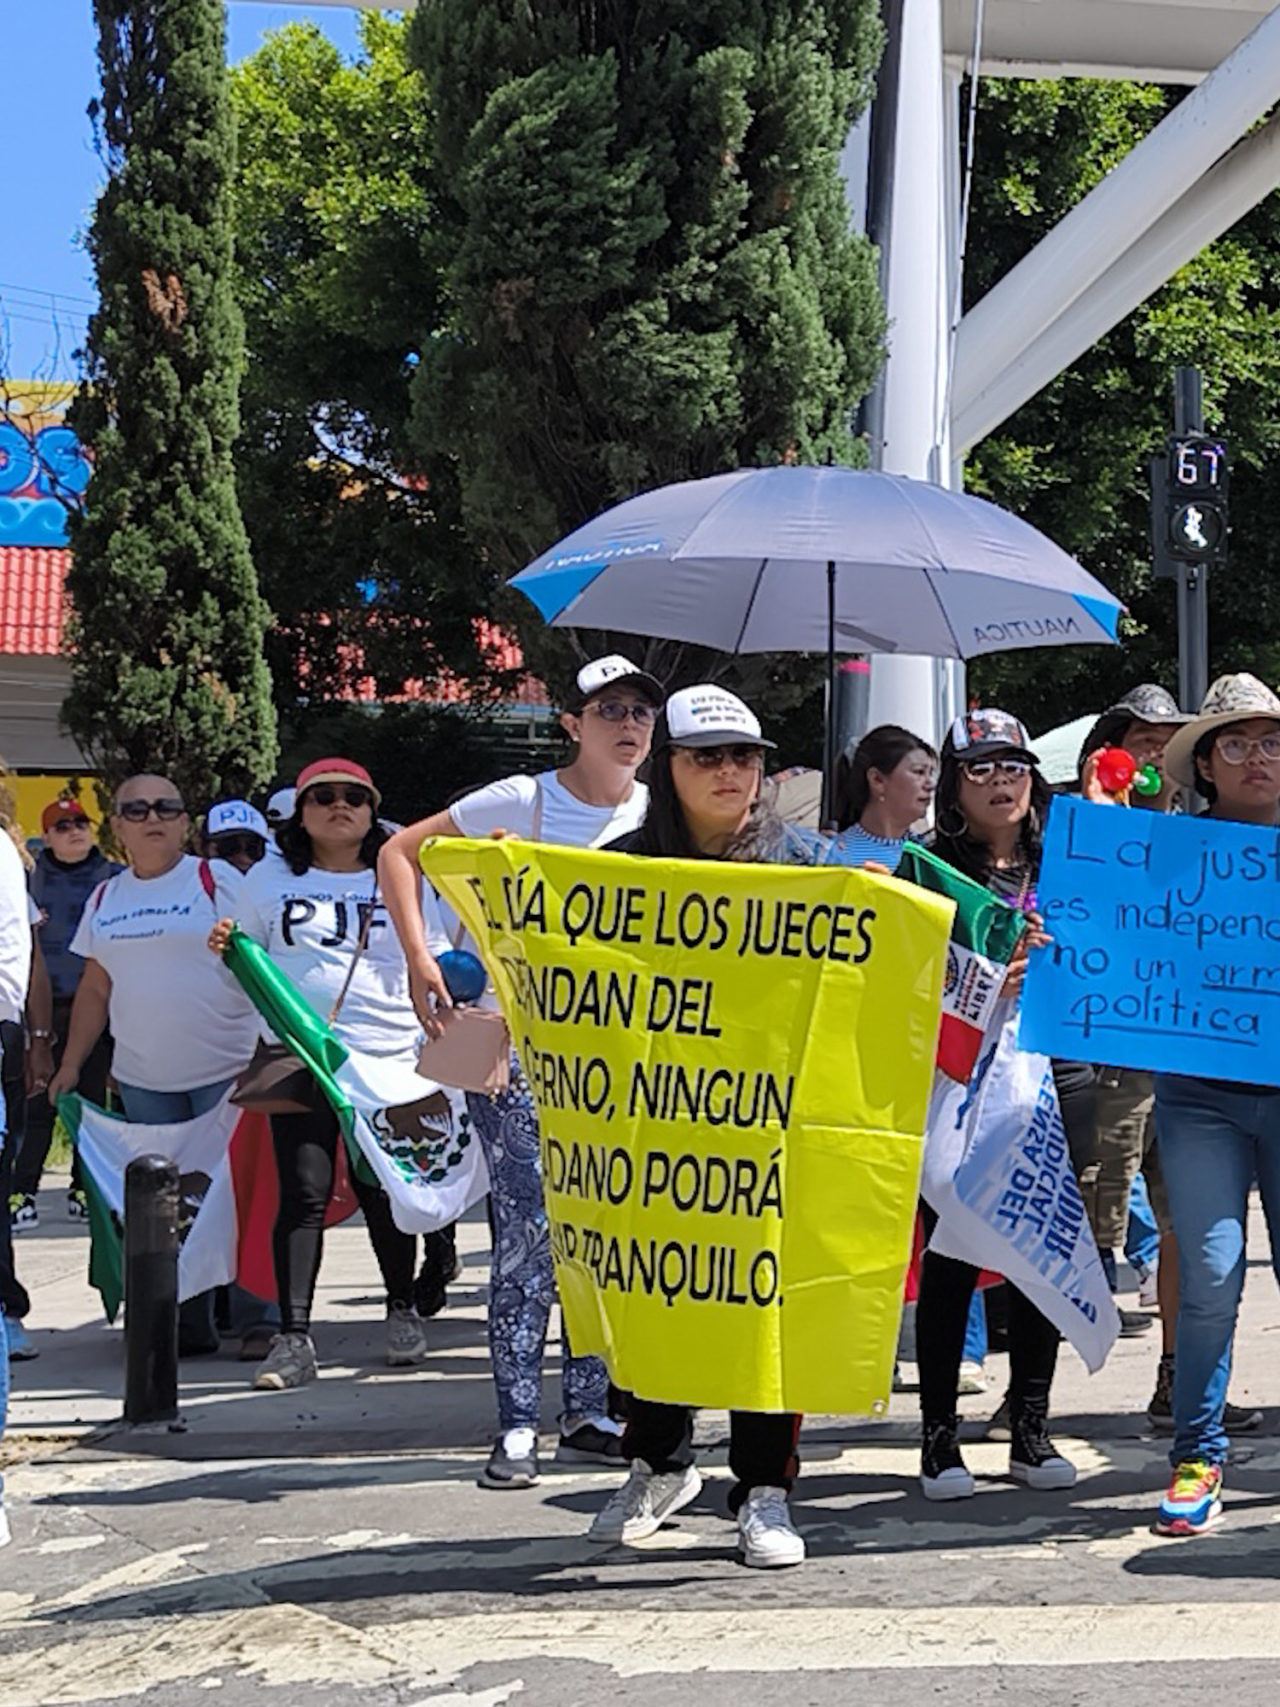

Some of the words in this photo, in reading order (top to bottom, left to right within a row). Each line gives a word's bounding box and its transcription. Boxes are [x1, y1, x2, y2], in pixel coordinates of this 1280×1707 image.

[1177, 448, 1219, 485] 67
[1066, 807, 1152, 871] La
[281, 898, 388, 950] PJF
[562, 883, 646, 947] QUE
[654, 890, 731, 951] LOS
[738, 898, 877, 964] JUECES
[1042, 896, 1091, 922] es
[1052, 942, 1111, 980] no
[1134, 956, 1177, 983] un
[646, 975, 723, 1038] DEL
[629, 1061, 795, 1131] NINGUN
[643, 1147, 784, 1220] PODRÁ
[582, 1228, 784, 1307] TRANQUILO.
